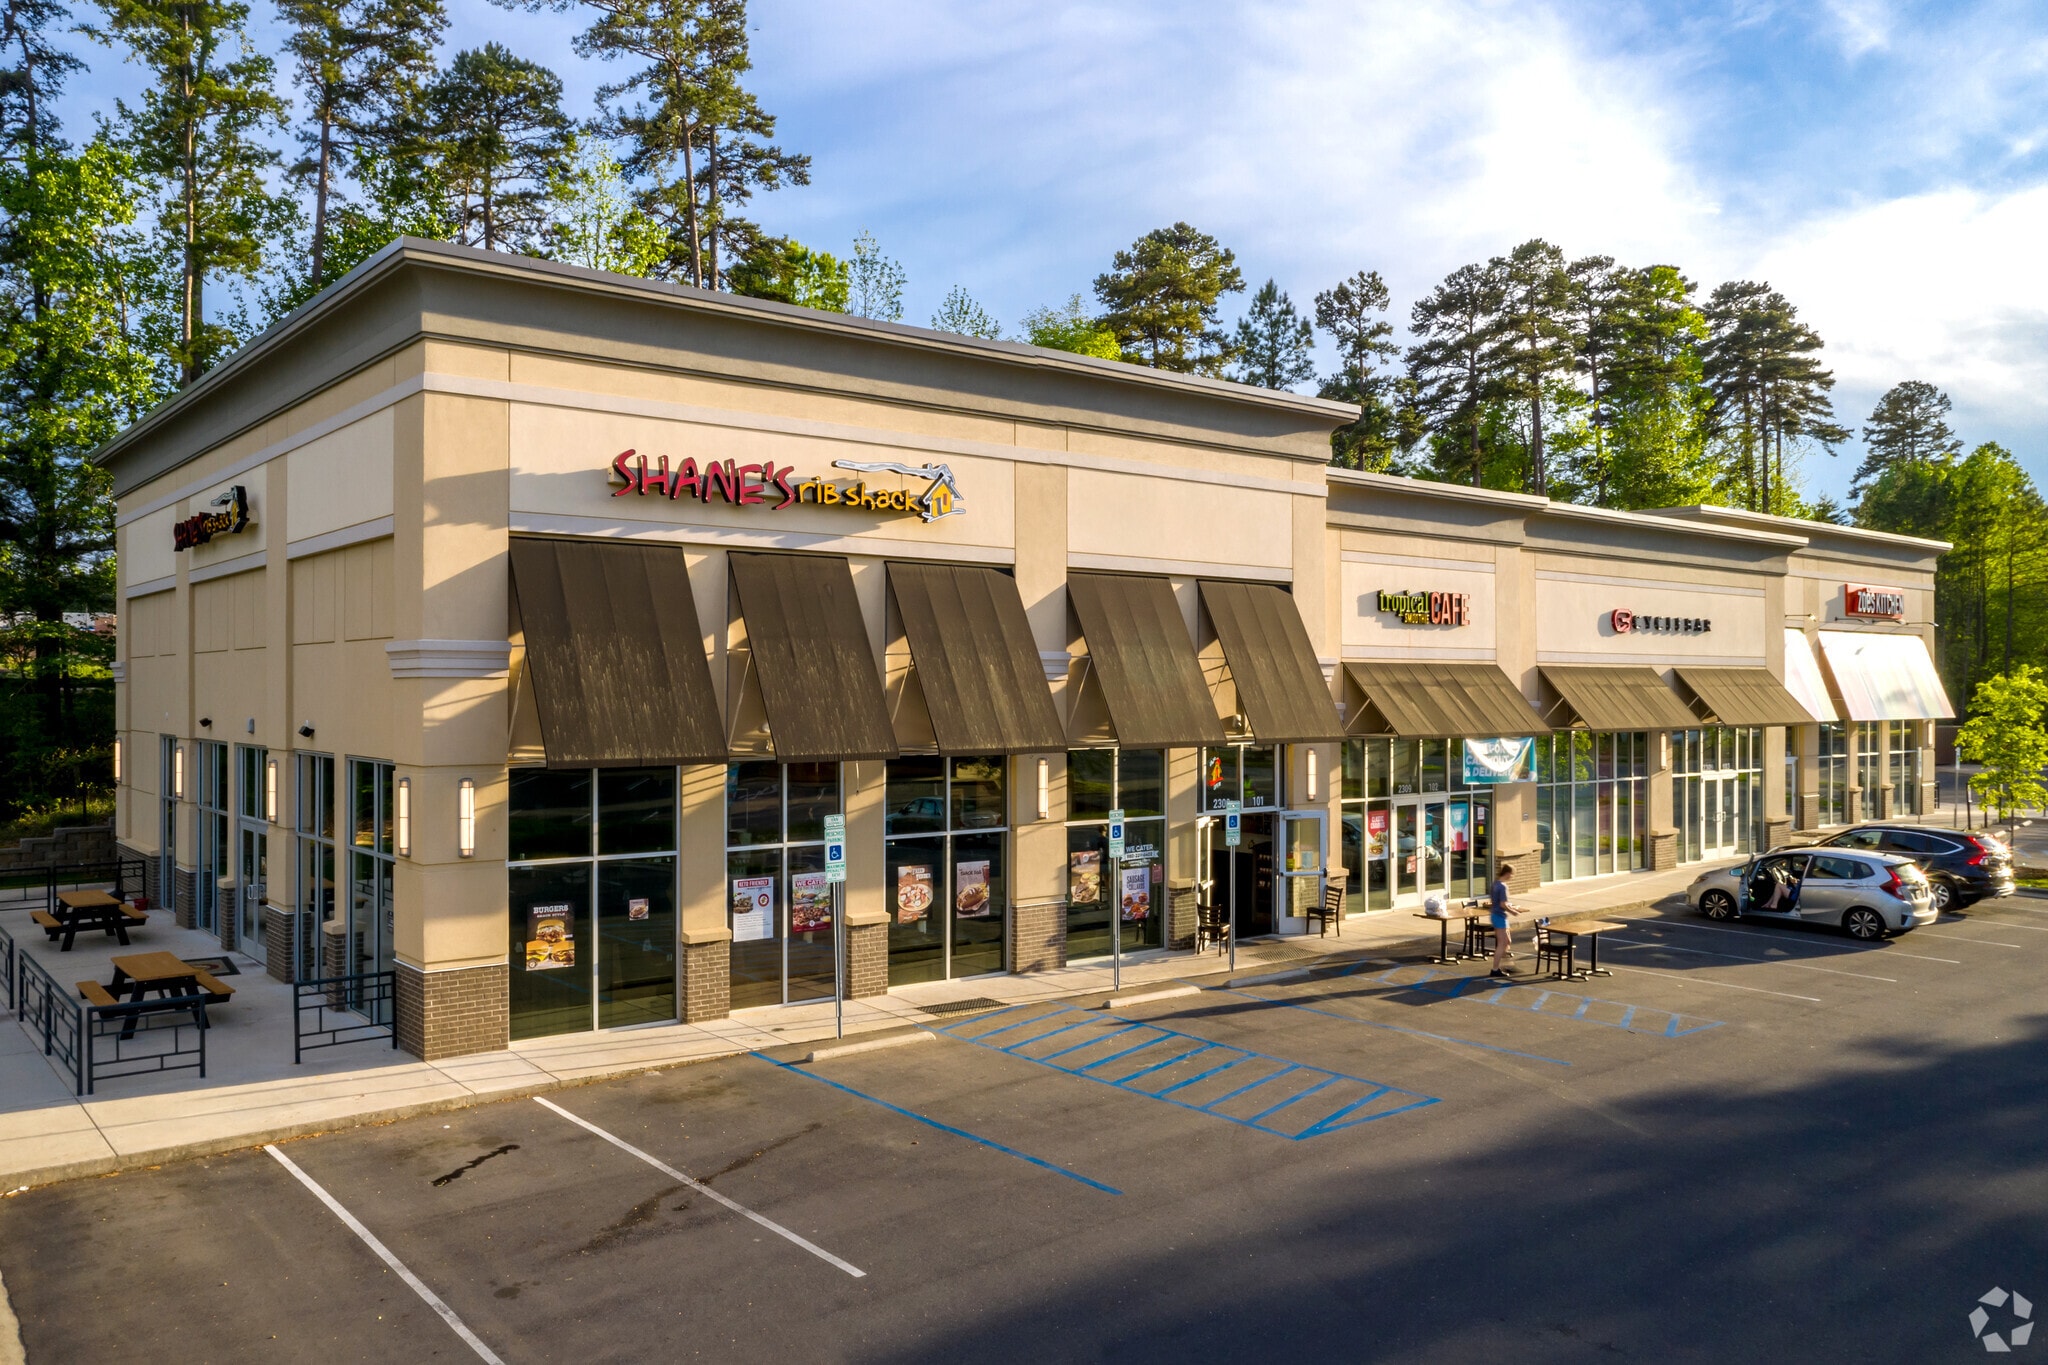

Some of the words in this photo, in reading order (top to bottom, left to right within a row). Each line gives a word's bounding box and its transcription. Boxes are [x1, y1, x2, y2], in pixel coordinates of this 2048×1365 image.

[612, 449, 795, 510] SHANE'S
[845, 482, 920, 511] shack
[1379, 589, 1430, 616] tropical
[1431, 592, 1470, 625] CAFE
[1252, 796, 1264, 806] 101
[1136, 843, 1154, 851] CATER
[533, 904, 569, 914] BURGERS
